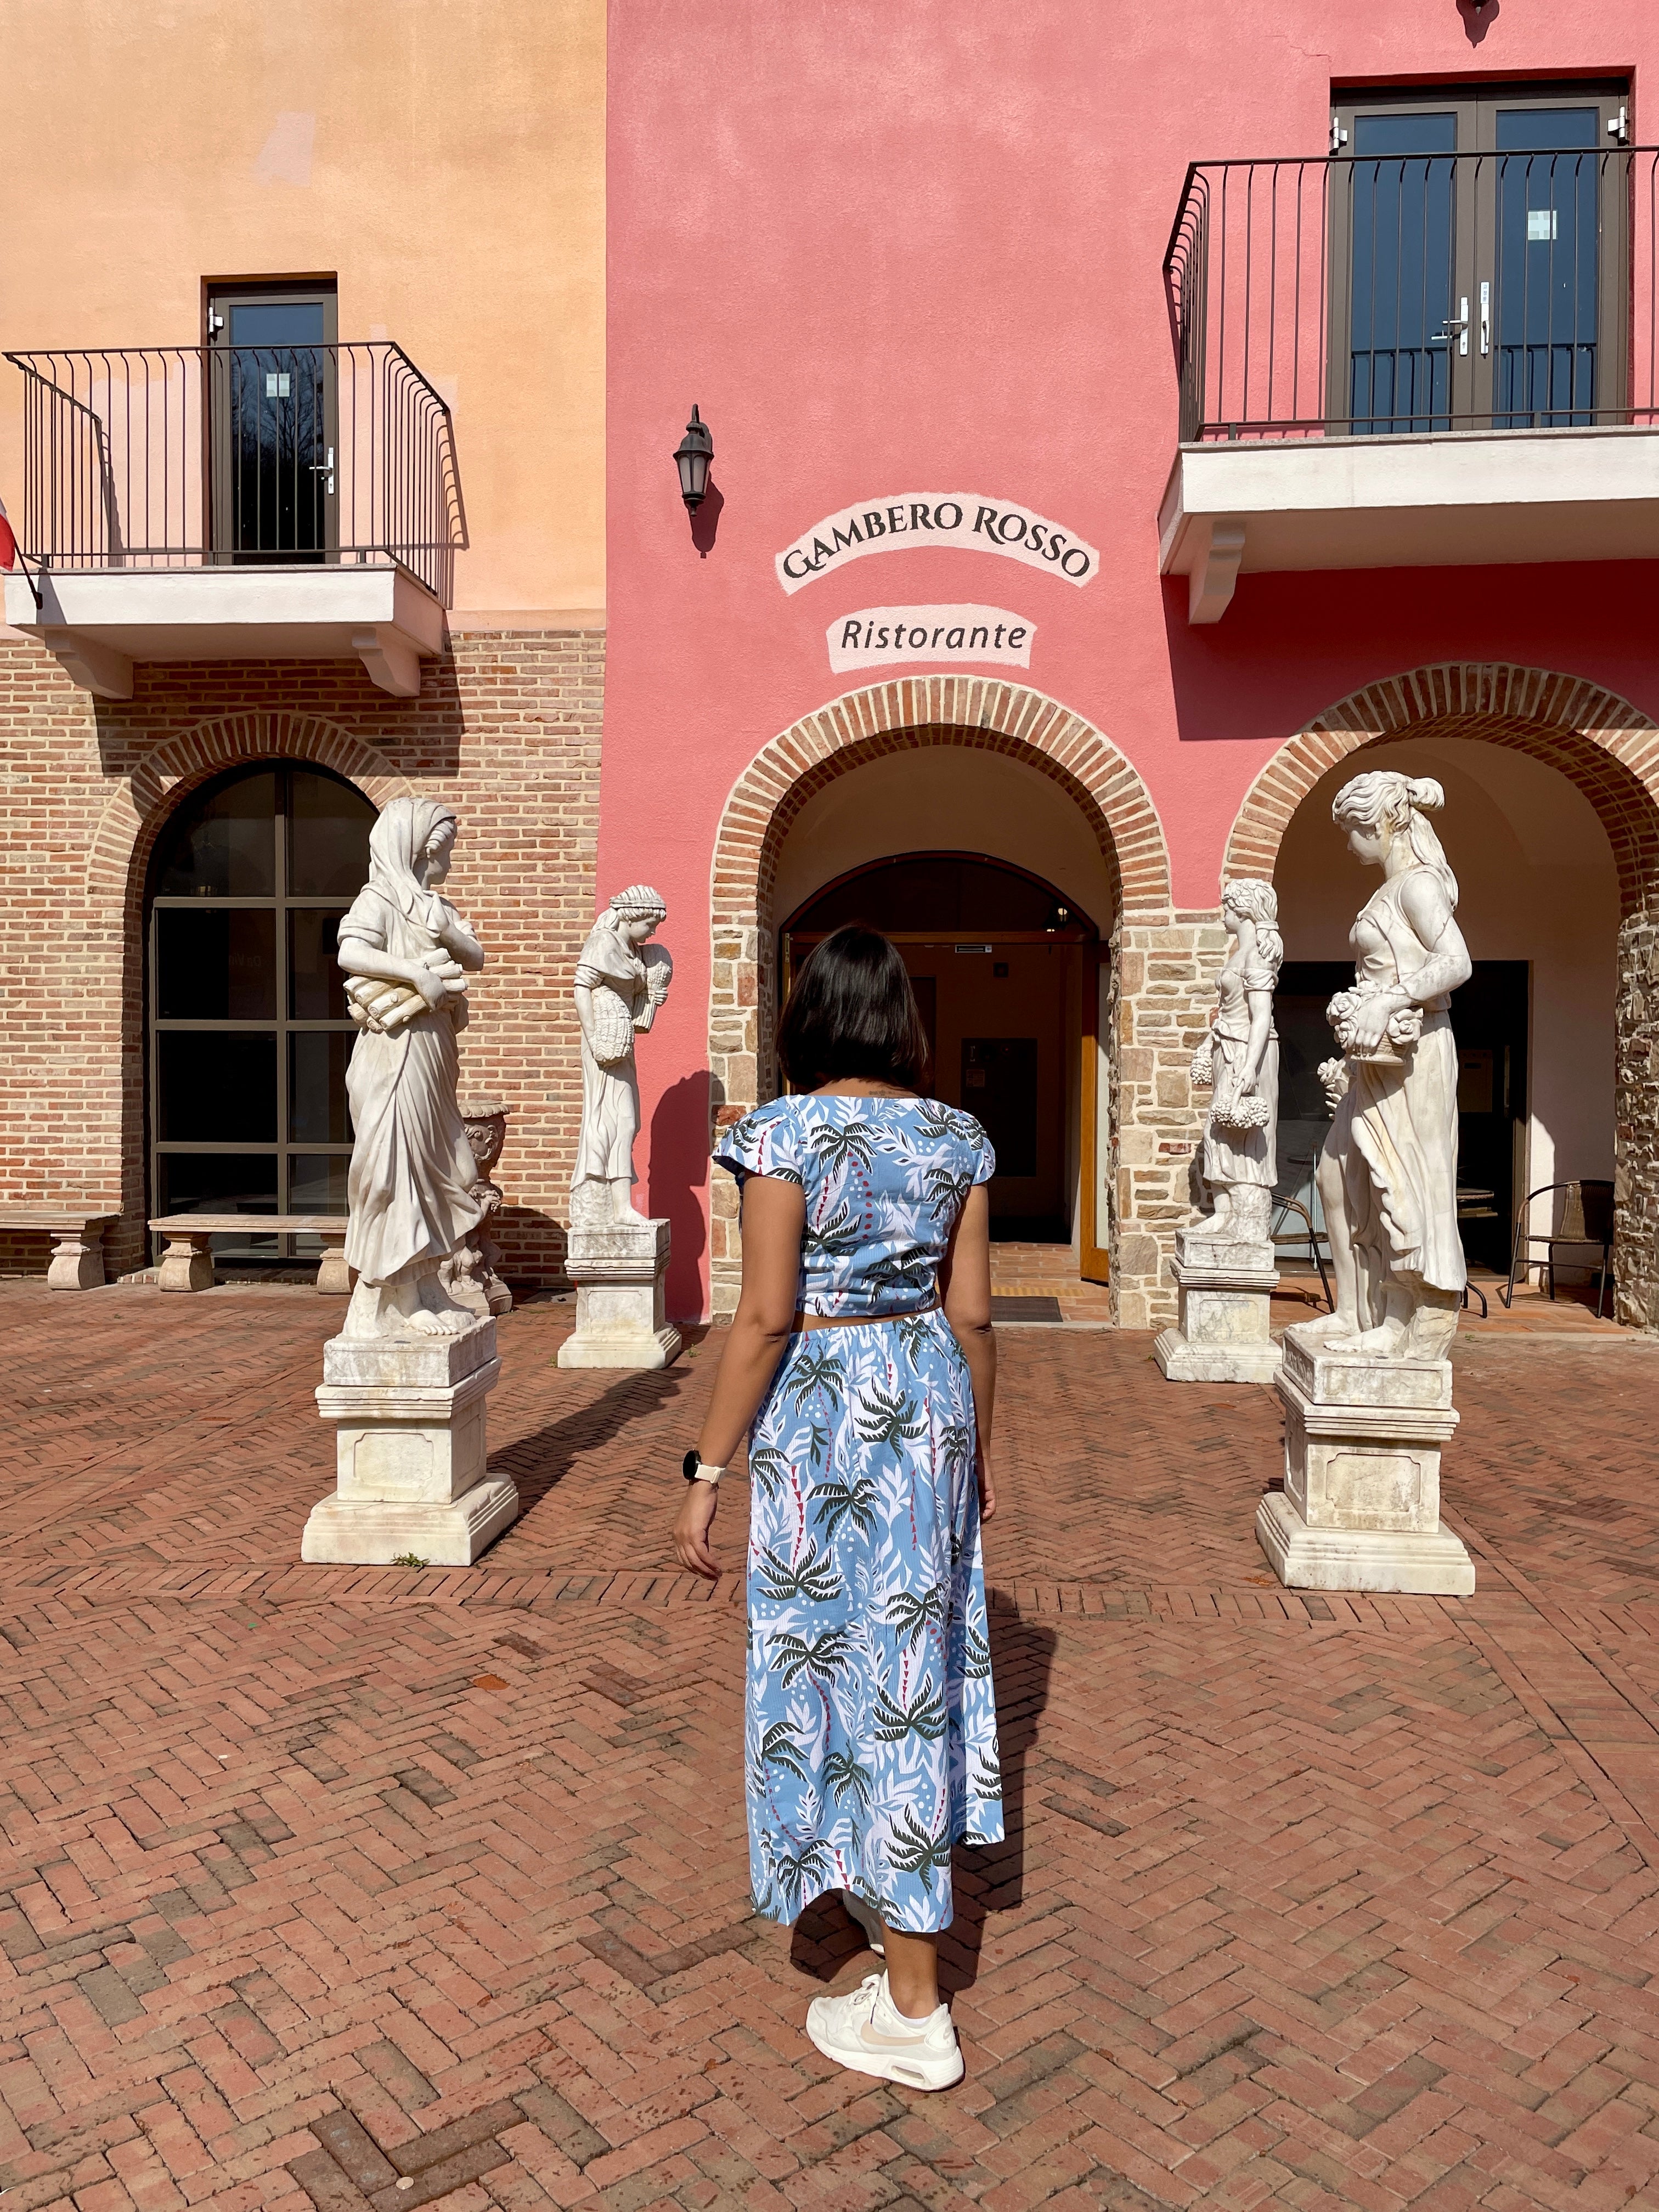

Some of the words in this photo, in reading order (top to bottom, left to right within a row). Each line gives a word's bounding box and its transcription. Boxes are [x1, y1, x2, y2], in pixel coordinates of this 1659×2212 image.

[784, 503, 963, 578] GAMBERO
[972, 506, 1090, 577] ROSSO
[842, 620, 1026, 649] Ristorante
